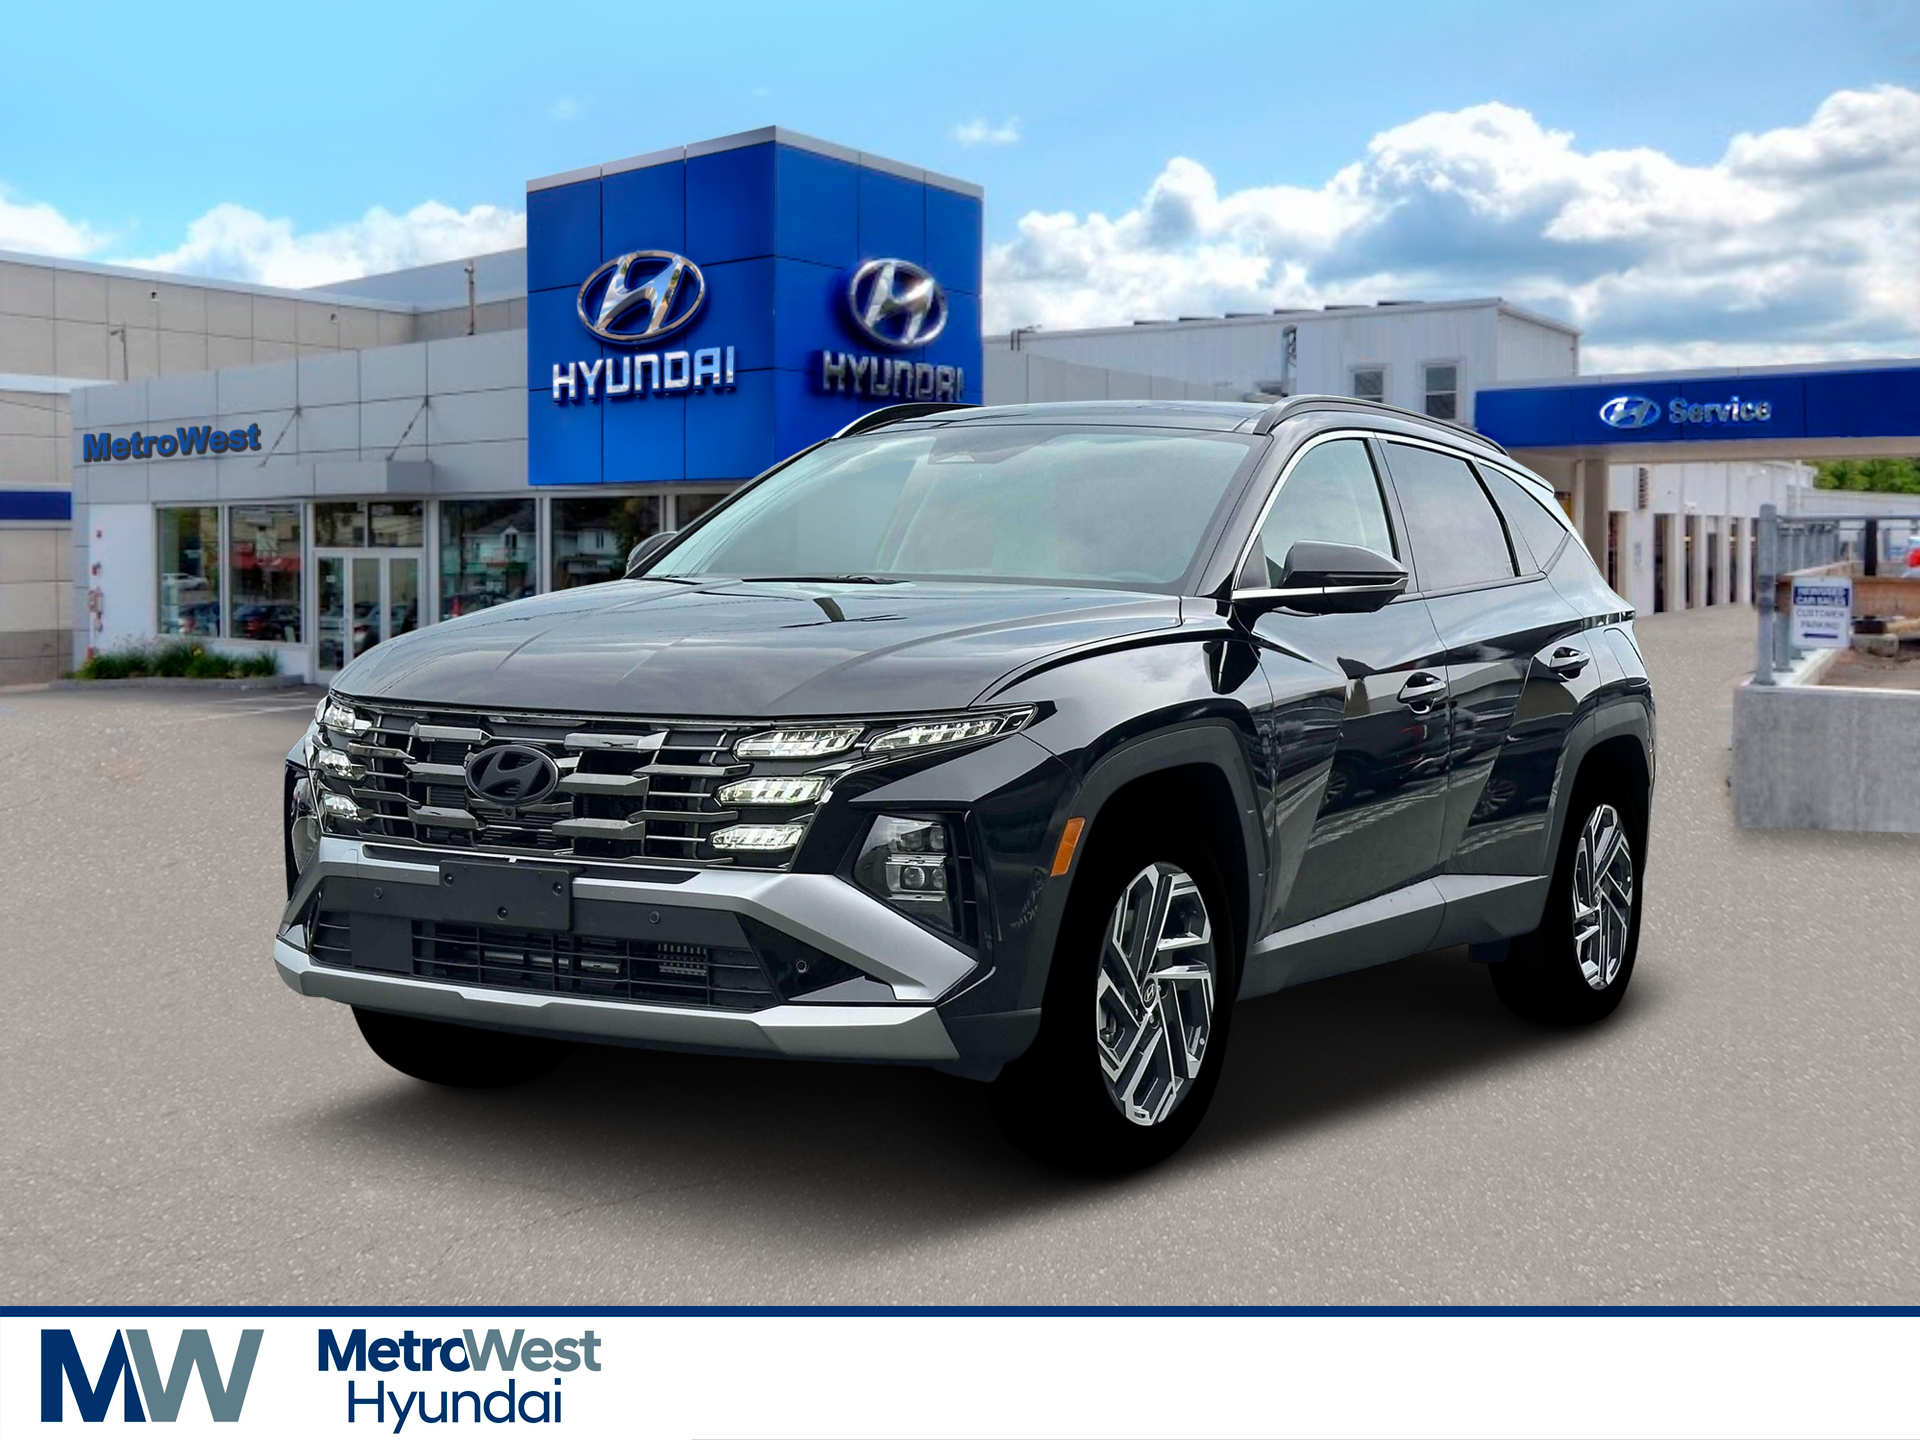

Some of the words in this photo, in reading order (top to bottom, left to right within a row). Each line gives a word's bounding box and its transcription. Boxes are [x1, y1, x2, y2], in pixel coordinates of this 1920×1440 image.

[552, 346, 736, 401] HYUNDAI
[822, 350, 963, 402] HYUNDAI
[1668, 396, 1771, 423] Service
[83, 423, 262, 462] MetroWest
[1796, 609, 1845, 618] CUSTOMER
[1800, 621, 1840, 630] PARKING
